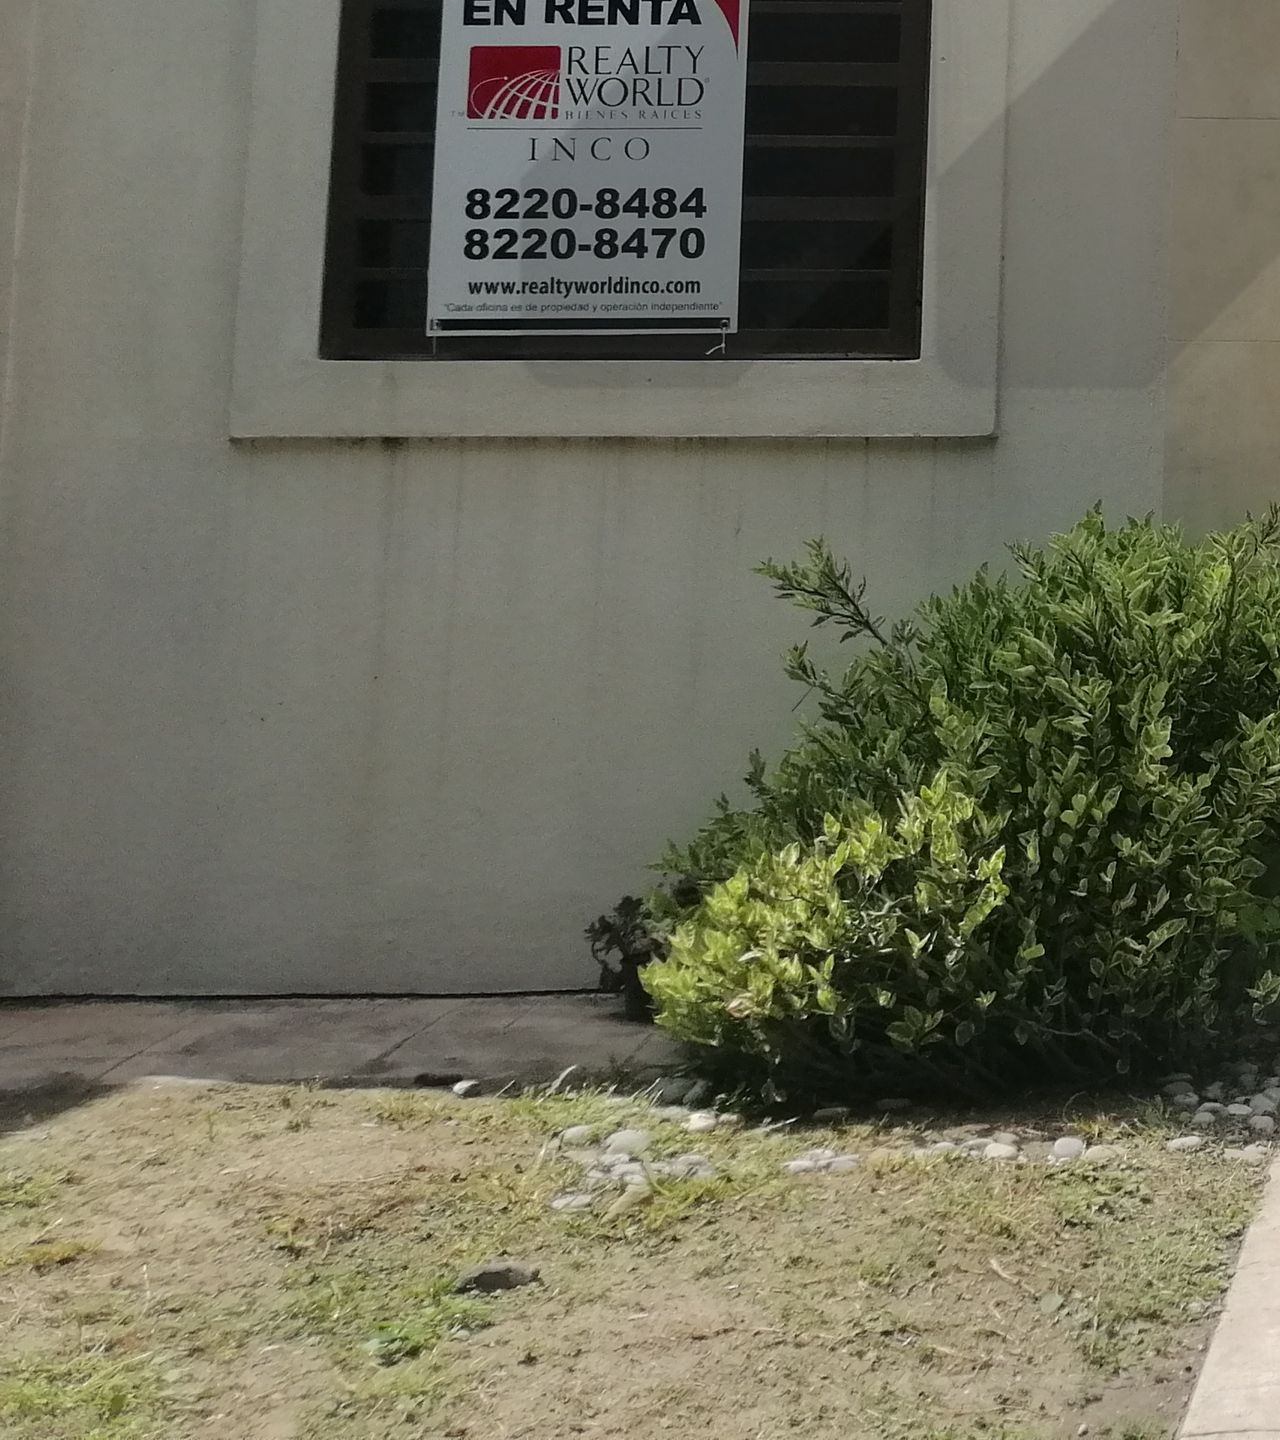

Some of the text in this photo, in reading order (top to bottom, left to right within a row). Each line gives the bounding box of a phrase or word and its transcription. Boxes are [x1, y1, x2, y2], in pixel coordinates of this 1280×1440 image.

[567, 46, 705, 75] REALTY
[565, 77, 705, 108] WORLD
[565, 110, 628, 120] BIENES
[528, 137, 650, 162] INCO
[465, 188, 707, 220] 8220-8484
[463, 227, 706, 261] 8220-8470
[468, 276, 701, 299] www.realtyworldinco.com
[475, 302, 508, 312] oficina
[510, 304, 522, 312] es
[525, 302, 538, 312] de
[540, 302, 590, 315] propiedad
